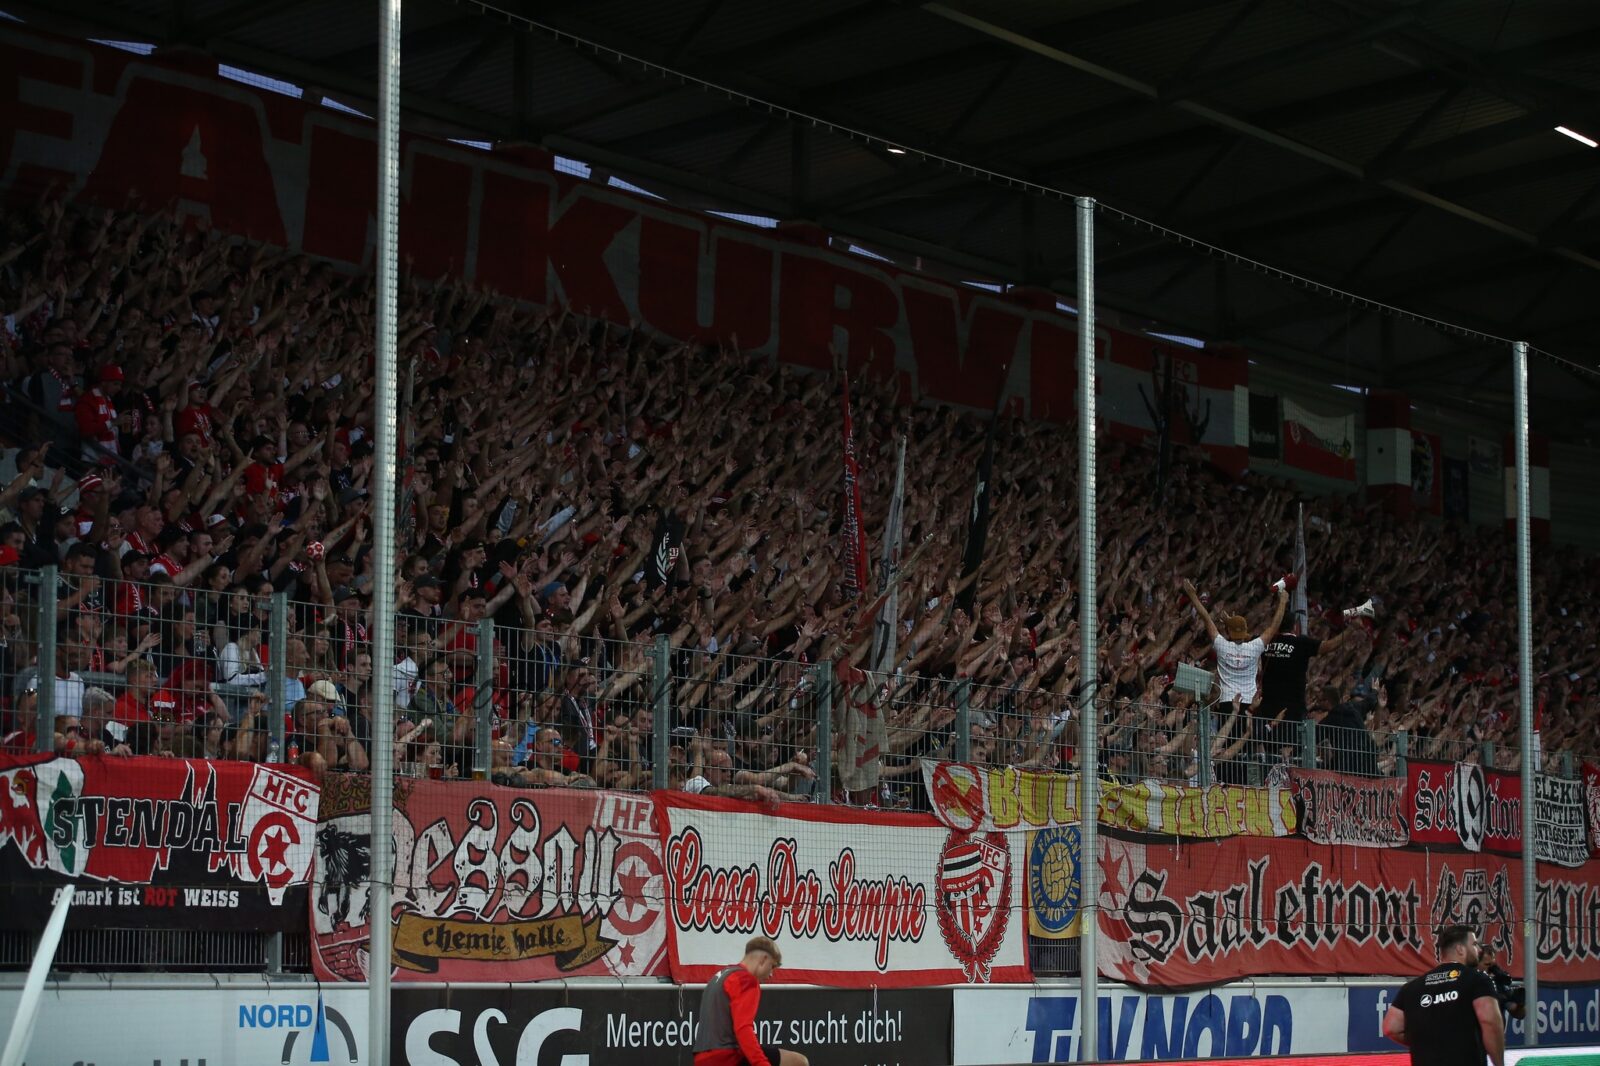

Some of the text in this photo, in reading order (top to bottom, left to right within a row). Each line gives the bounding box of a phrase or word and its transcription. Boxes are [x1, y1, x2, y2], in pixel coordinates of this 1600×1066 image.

[264, 775, 310, 814] HFC
[52, 794, 249, 852] STENDAL
[118, 887, 141, 906] ist
[144, 886, 178, 907] ROT
[184, 888, 240, 908] WEISS
[668, 825, 928, 973] Coesa Per Sempre
[1466, 874, 1485, 891] HFC
[1122, 854, 1421, 966] Saalefront
[423, 924, 506, 952] chemie
[512, 925, 569, 957] halle
[1433, 990, 1459, 1004] JAKO
[239, 1004, 313, 1028] NORD
[789, 1011, 848, 1045] sucht
[854, 1010, 903, 1044] dich!
[1142, 993, 1293, 1061] NORD
